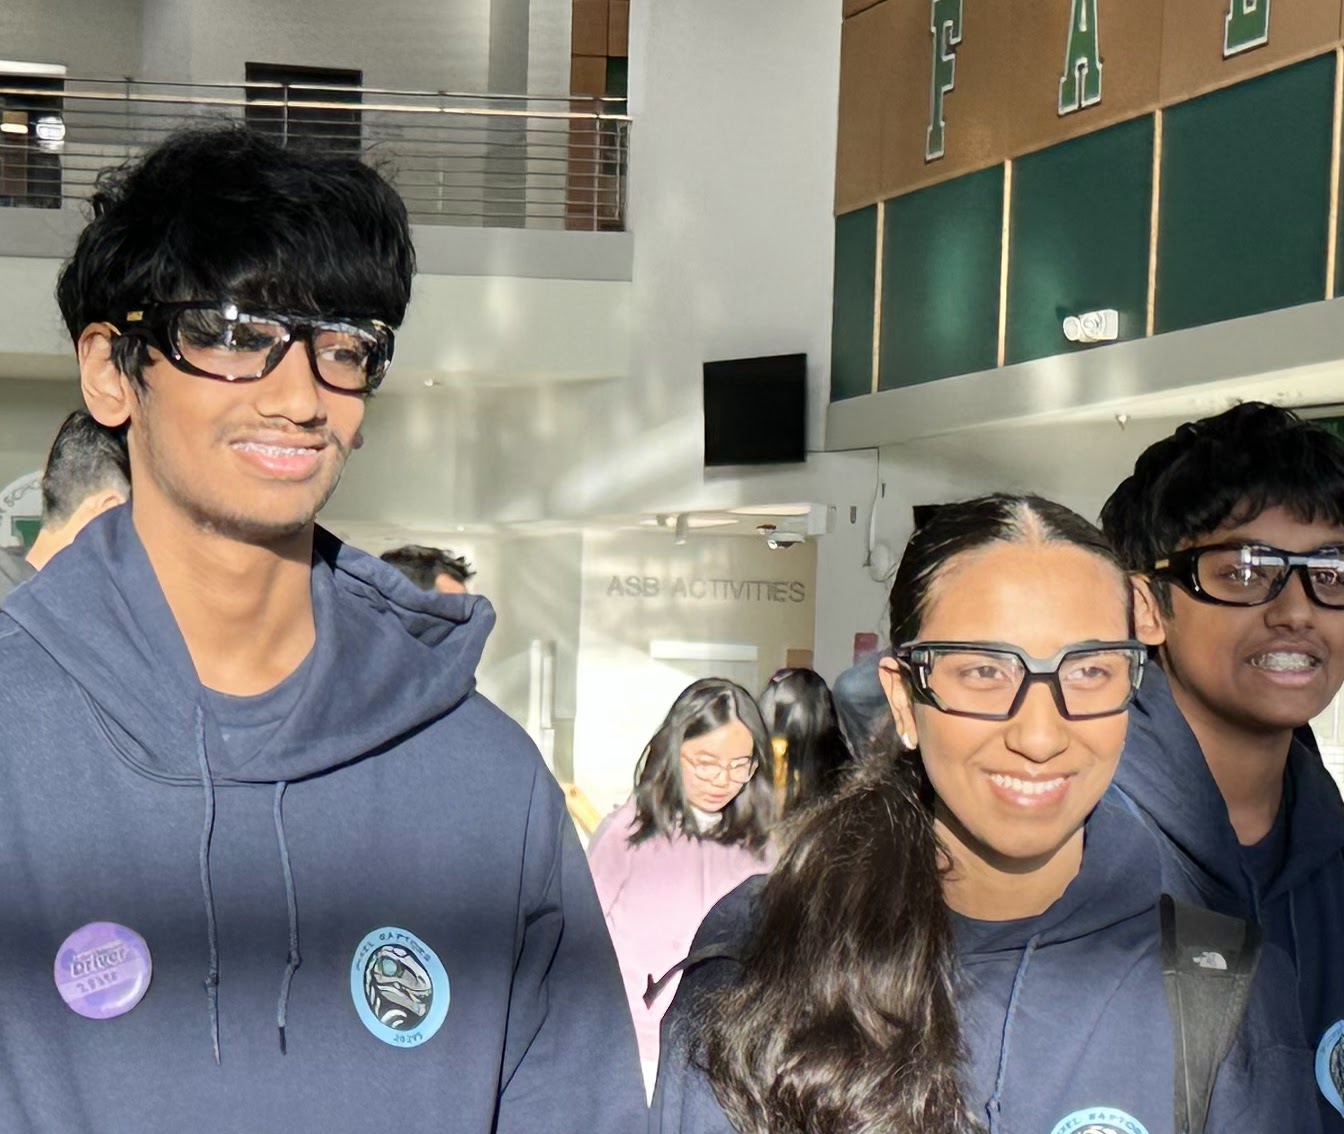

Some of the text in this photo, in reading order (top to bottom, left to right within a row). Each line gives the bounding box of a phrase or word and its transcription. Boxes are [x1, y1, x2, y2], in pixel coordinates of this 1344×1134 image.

[606, 575, 806, 603] ASB ACTIVITIES
[70, 947, 126, 978] Driver
